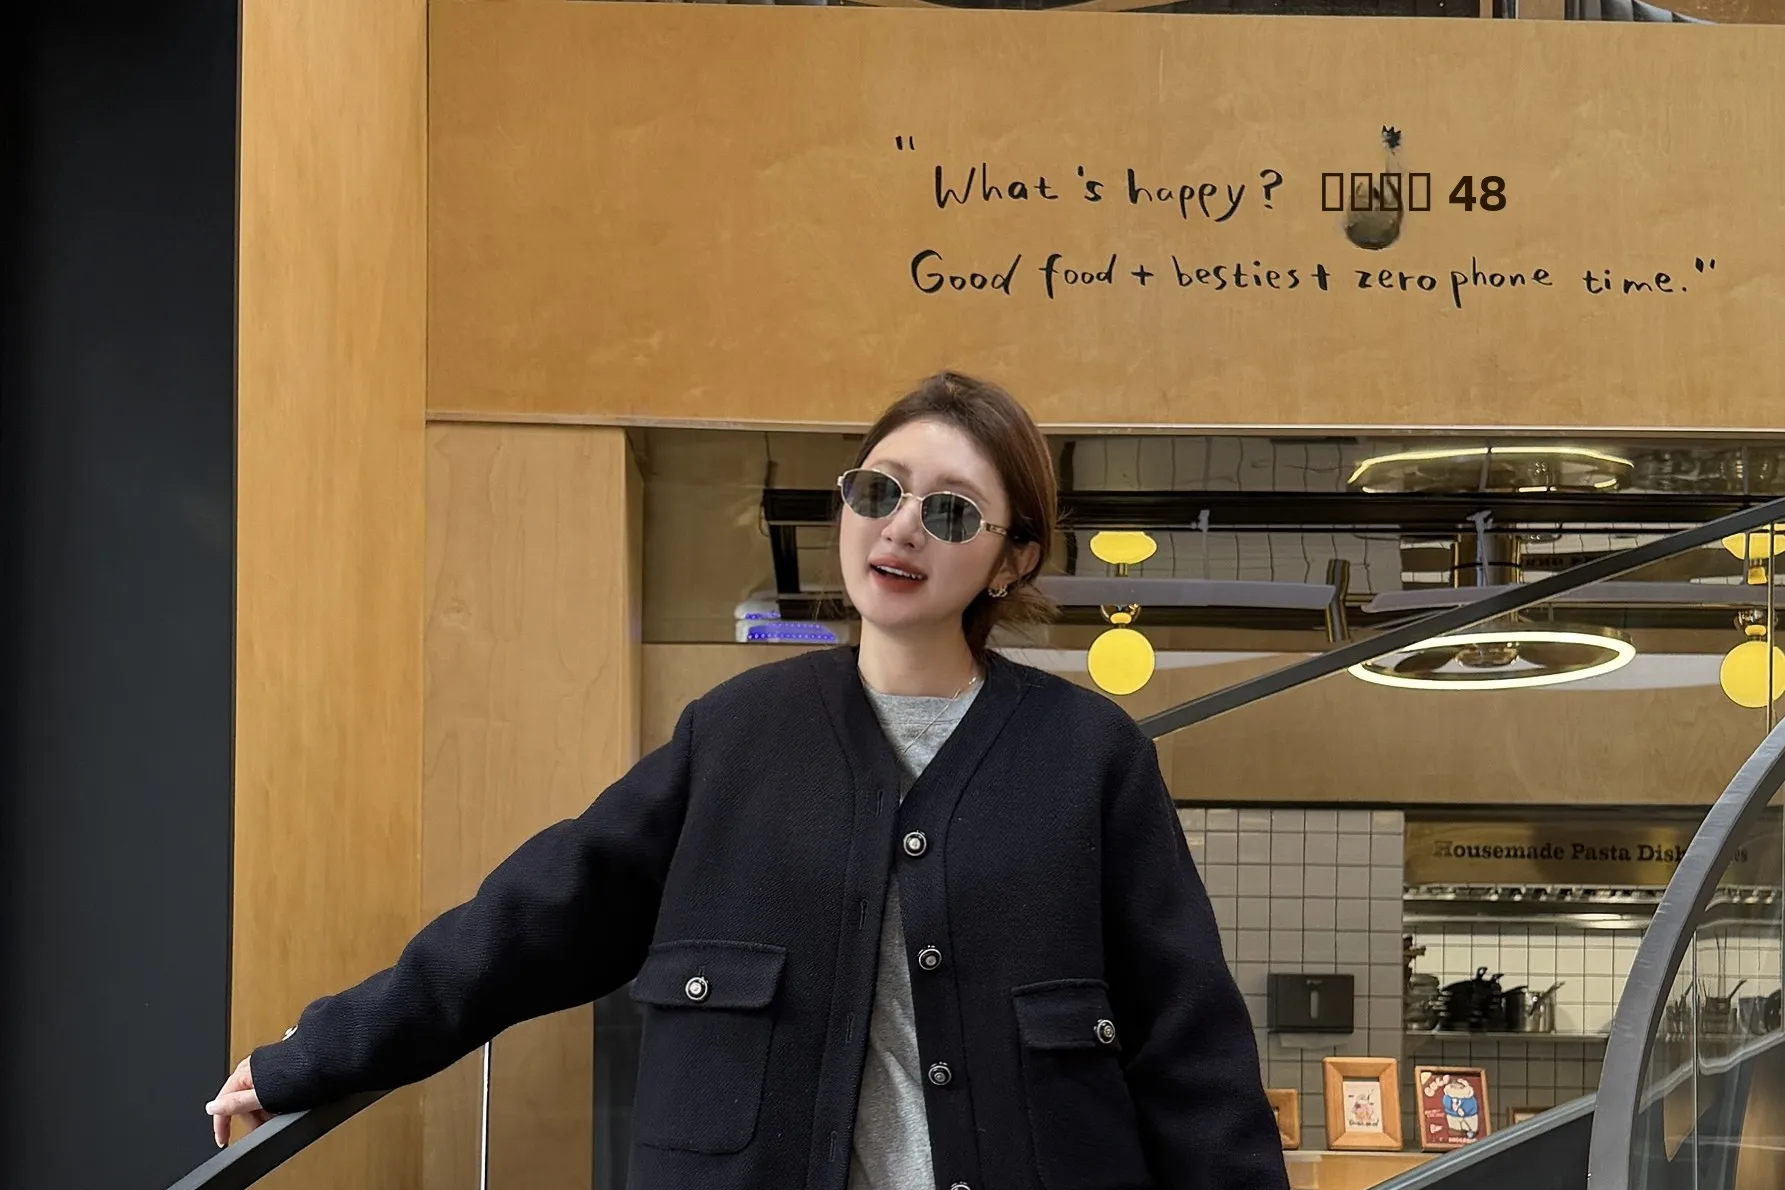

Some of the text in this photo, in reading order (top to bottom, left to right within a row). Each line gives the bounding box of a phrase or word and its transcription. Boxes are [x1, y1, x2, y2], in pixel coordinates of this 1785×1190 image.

[1126, 168, 1284, 223] happy?
[910, 249, 1022, 296] Good
[1038, 253, 1118, 300] food
[1130, 264, 1155, 287] +
[1171, 255, 1301, 291] besties
[1432, 839, 1565, 861] Housemade
[1570, 842, 1632, 862] Pasta
